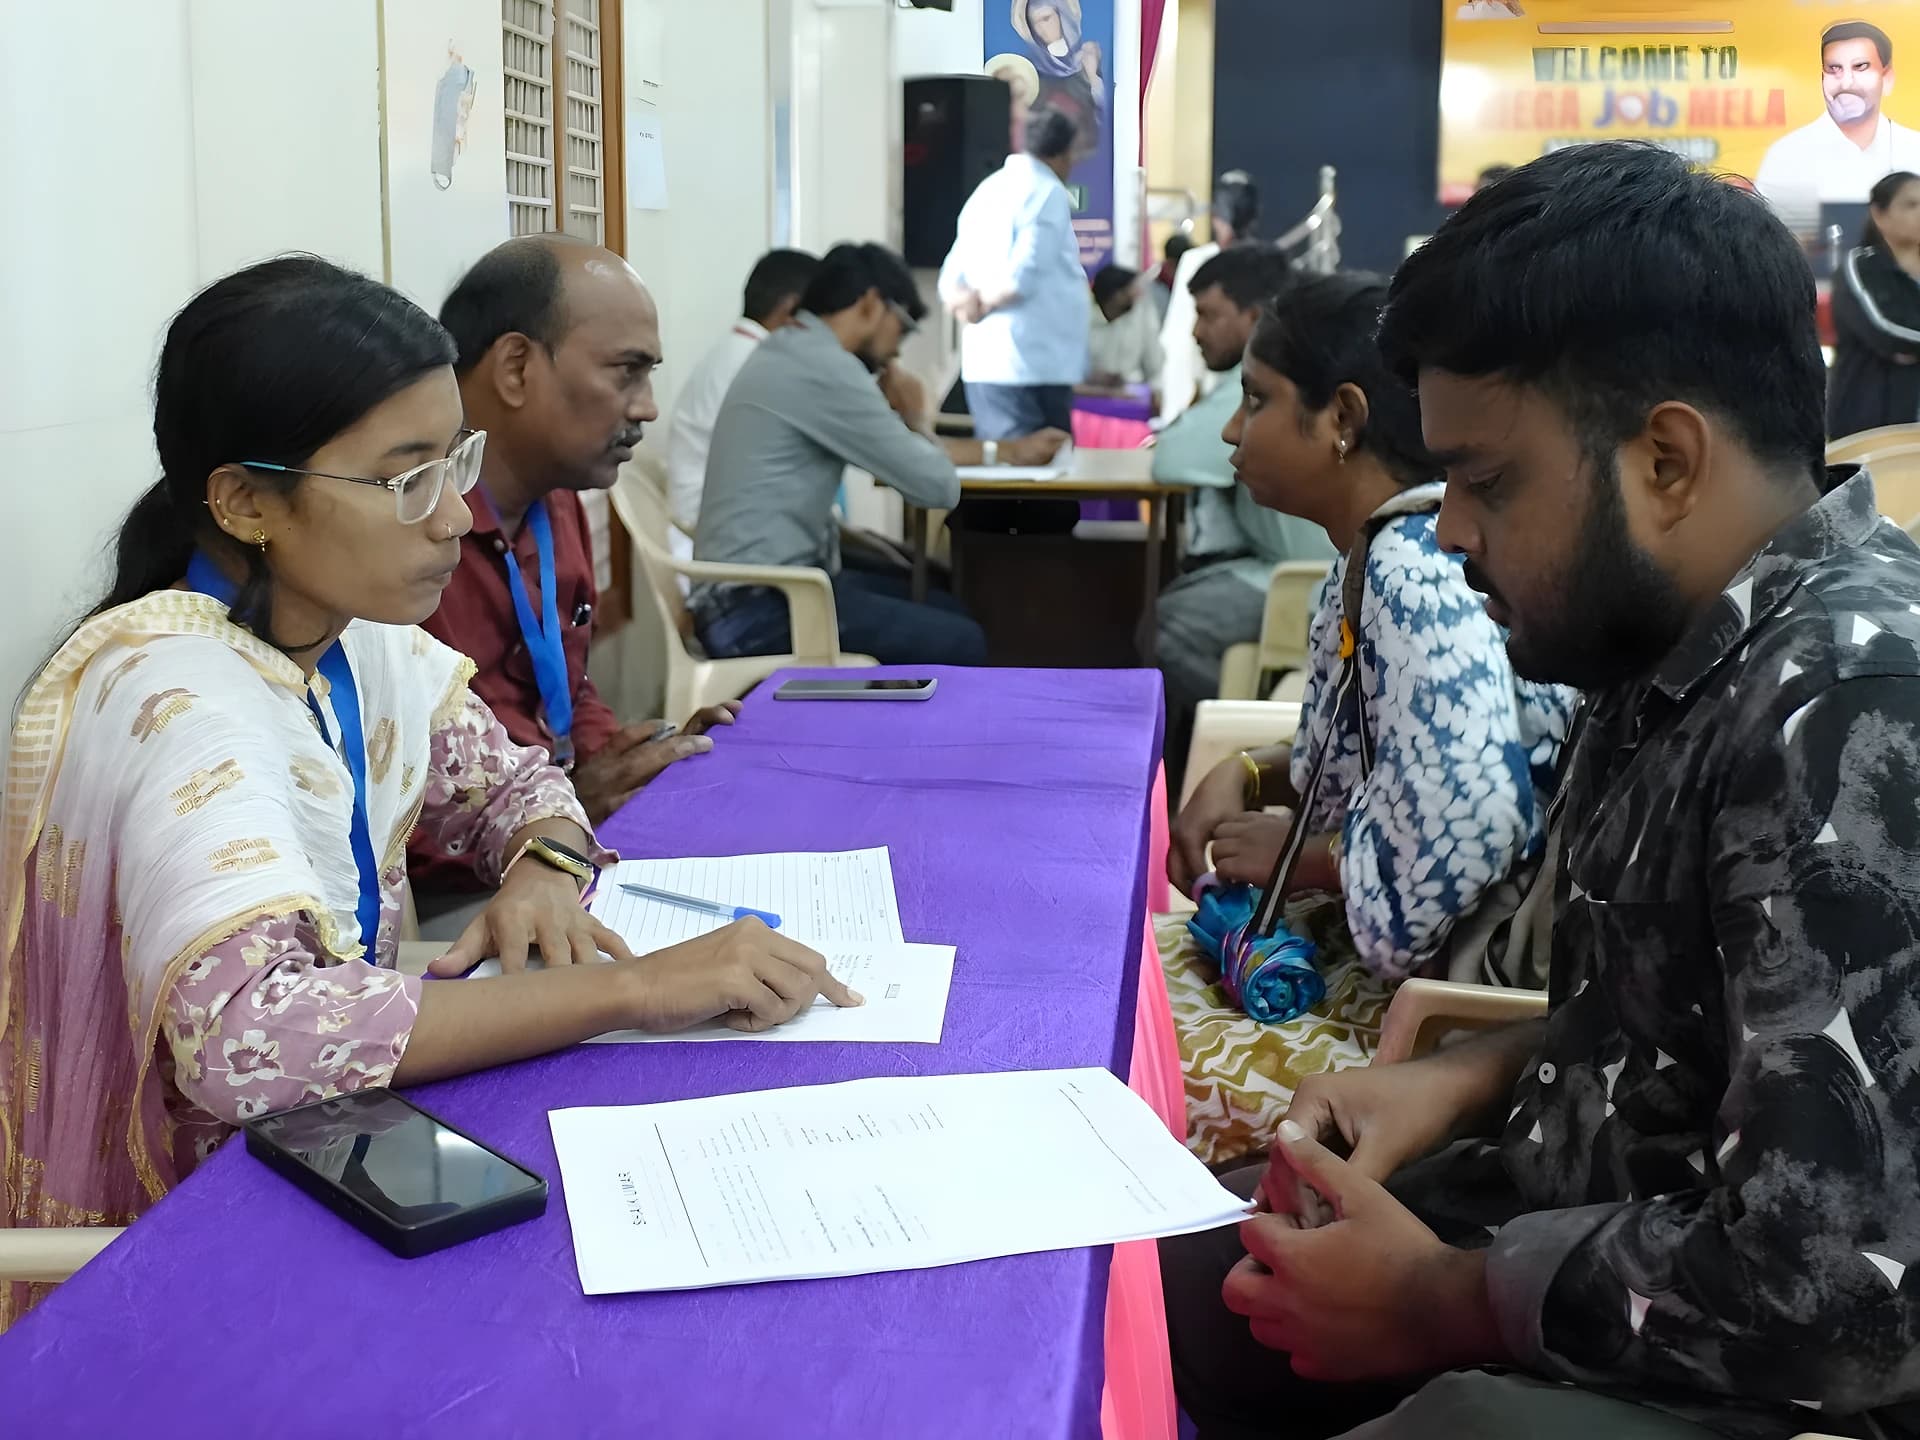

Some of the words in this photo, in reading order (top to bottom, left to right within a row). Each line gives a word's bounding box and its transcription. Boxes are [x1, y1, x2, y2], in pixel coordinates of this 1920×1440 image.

[1532, 46, 1688, 81] WELCOME
[1700, 45, 1738, 80] TO
[1688, 88, 1786, 127] MELA
